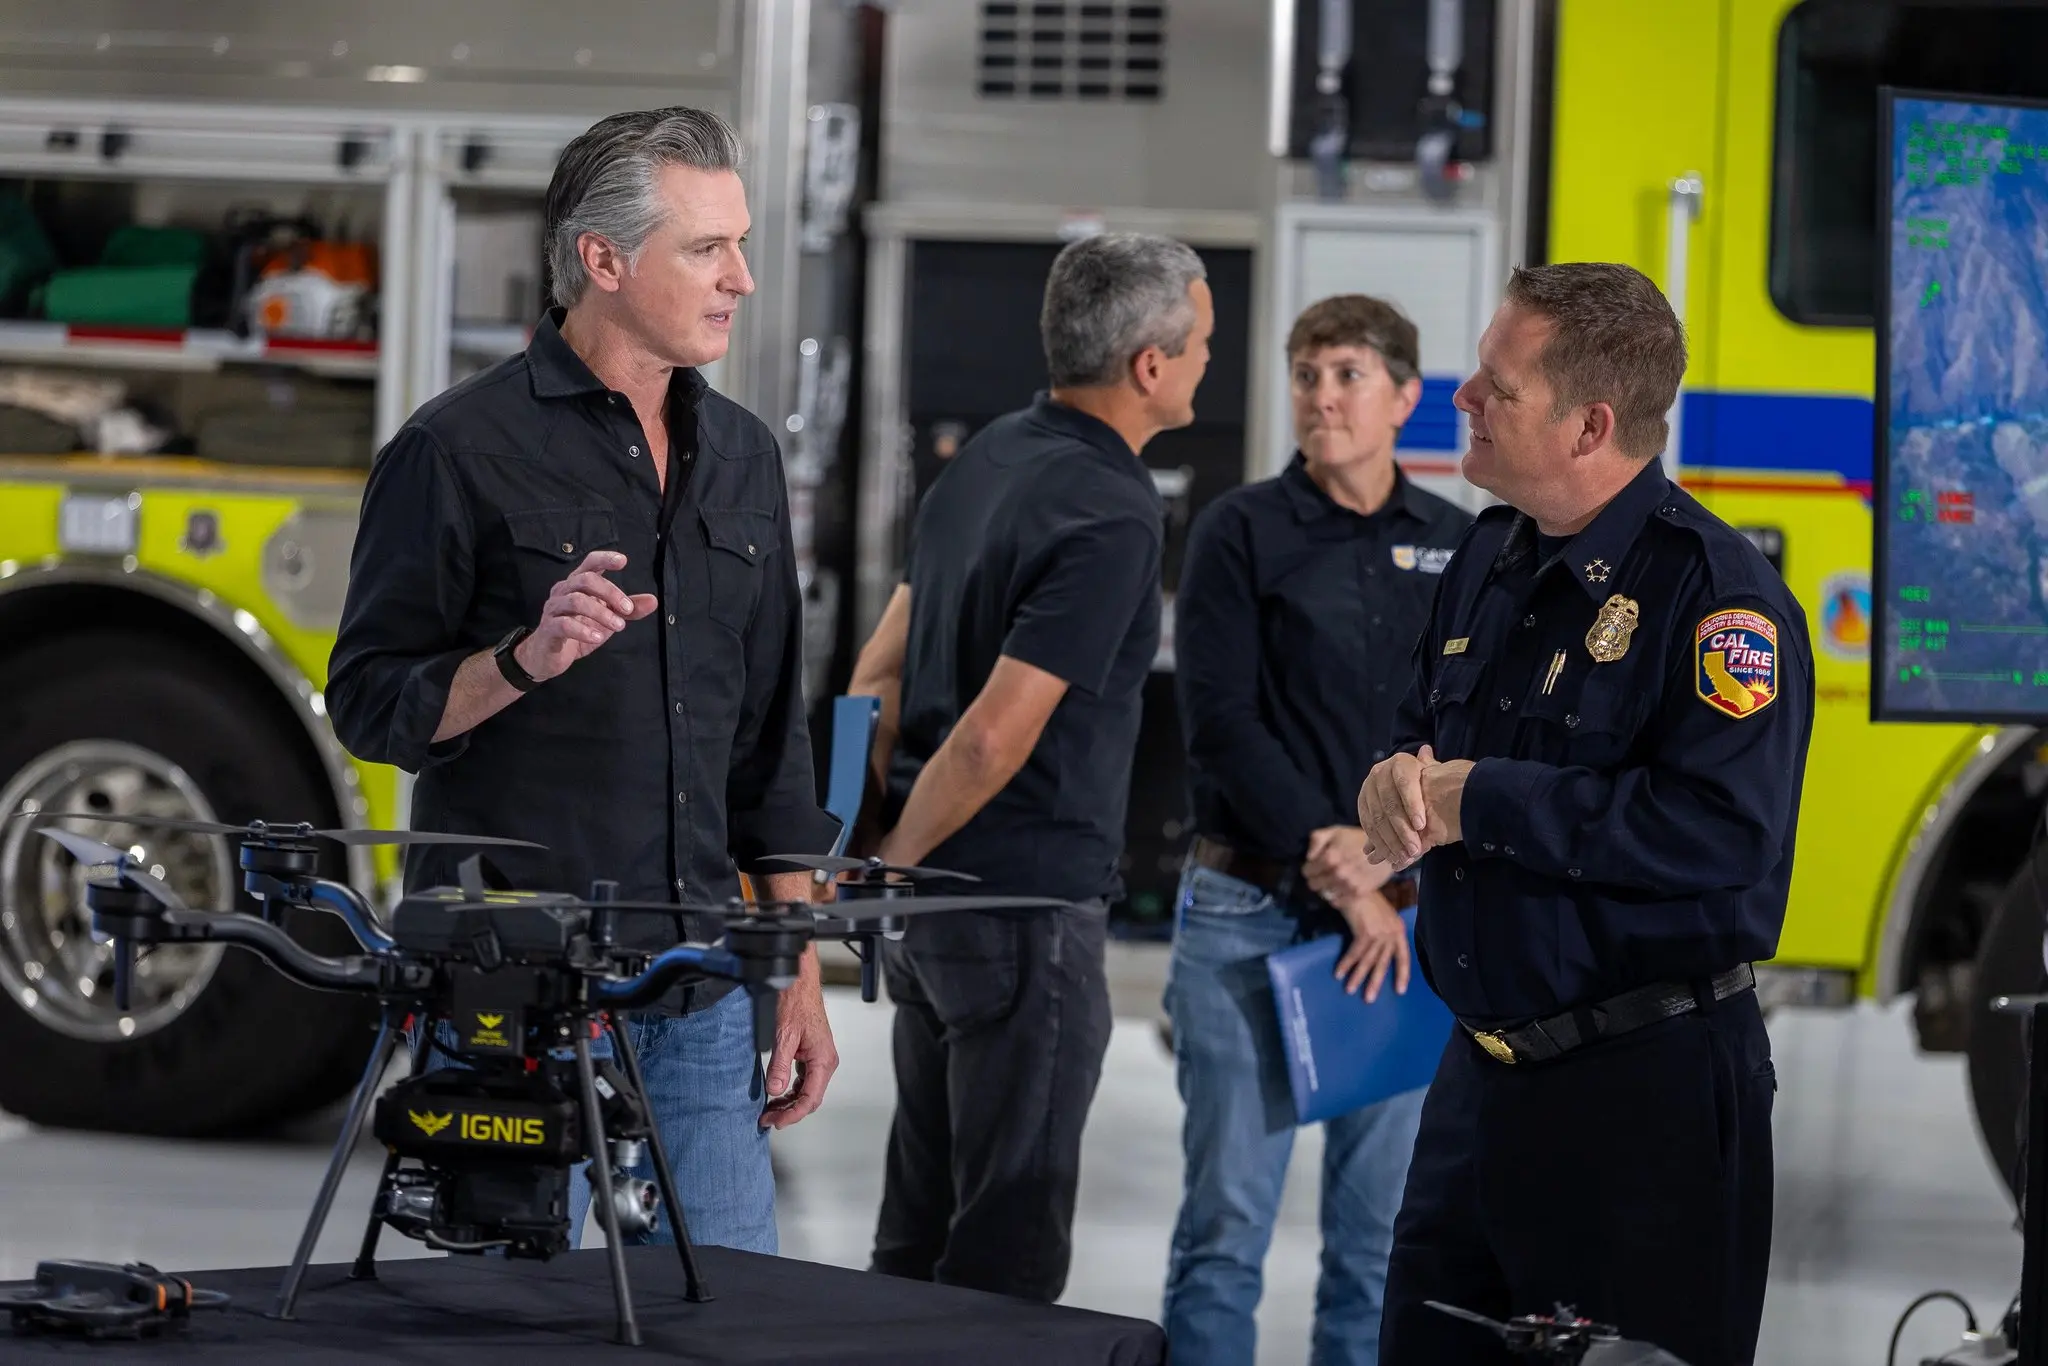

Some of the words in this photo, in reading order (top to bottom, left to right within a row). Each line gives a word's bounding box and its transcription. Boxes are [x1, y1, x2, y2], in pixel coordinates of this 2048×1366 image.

[1700, 613, 1732, 631] CALIFORNIA
[1733, 613, 1768, 627] DEPARTMENT
[1700, 620, 1726, 638] FORESTRY
[1745, 620, 1775, 640] PROTECTION
[1710, 633, 1750, 649] CAL
[1728, 649, 1773, 667] FIRE
[460, 1113, 545, 1145] IGNIS
